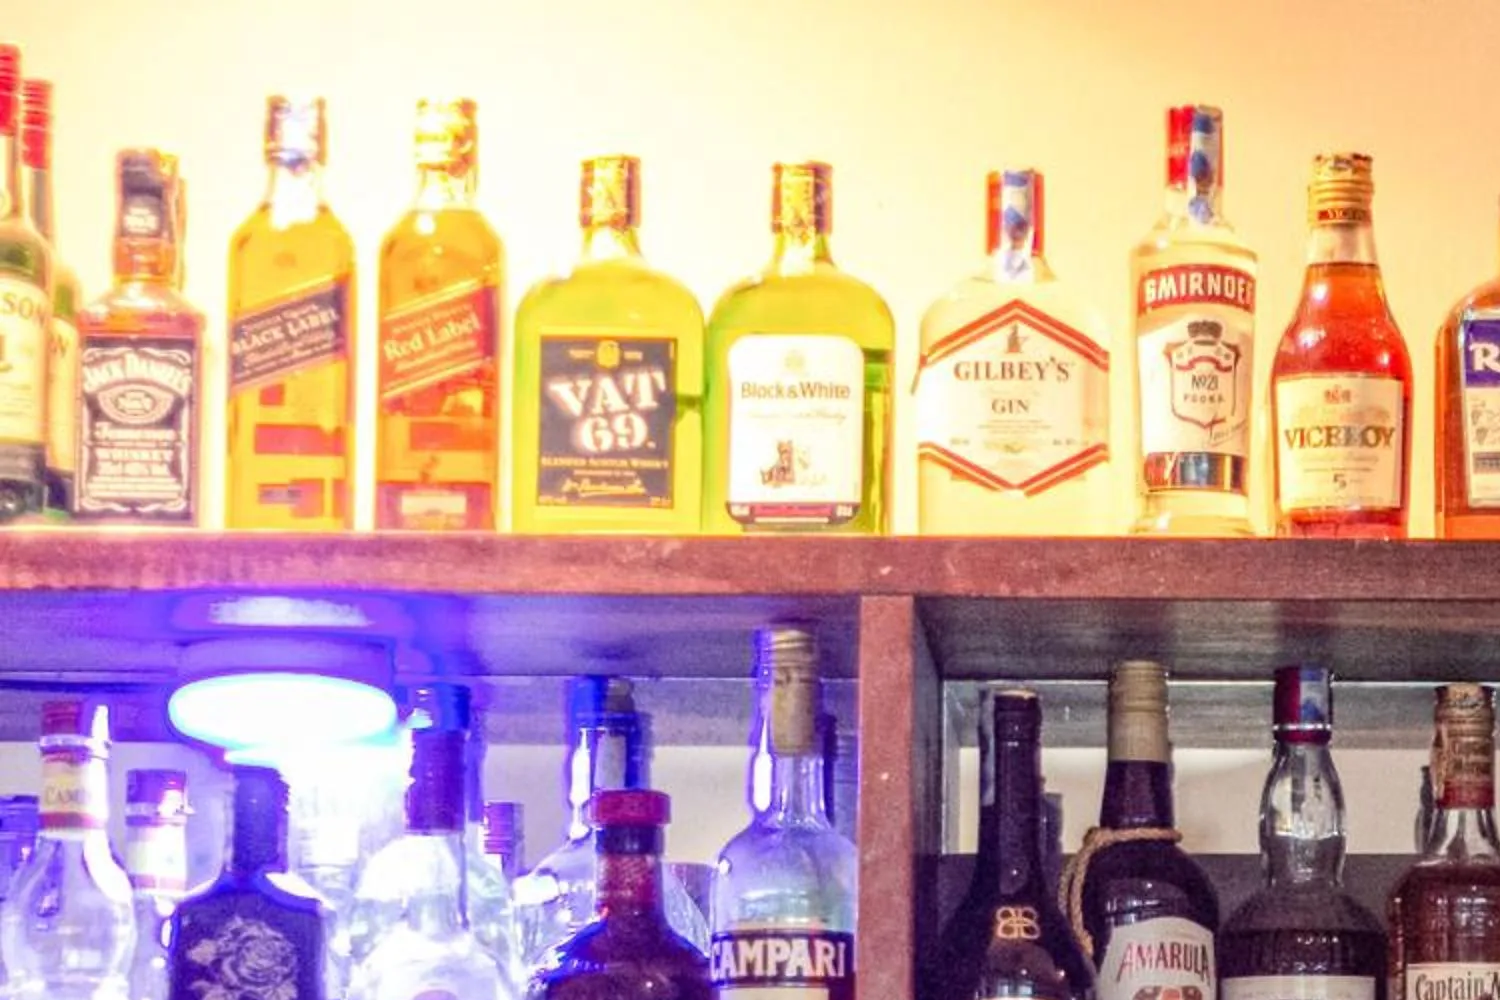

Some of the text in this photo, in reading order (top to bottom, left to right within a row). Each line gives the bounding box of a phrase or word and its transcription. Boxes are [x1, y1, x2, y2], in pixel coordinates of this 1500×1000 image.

[233, 327, 285, 354] BLACK
[288, 308, 338, 339] LABEL
[384, 312, 480, 360] Red Label
[83, 351, 192, 398] JACK DANIEL'S
[953, 357, 1072, 382] GILBEY'S
[548, 369, 667, 417] VAT
[991, 400, 1030, 415] GIN
[1284, 425, 1396, 451] VICEROY
[711, 932, 847, 980] CAMPARI
[1115, 940, 1211, 986] AMARULA
